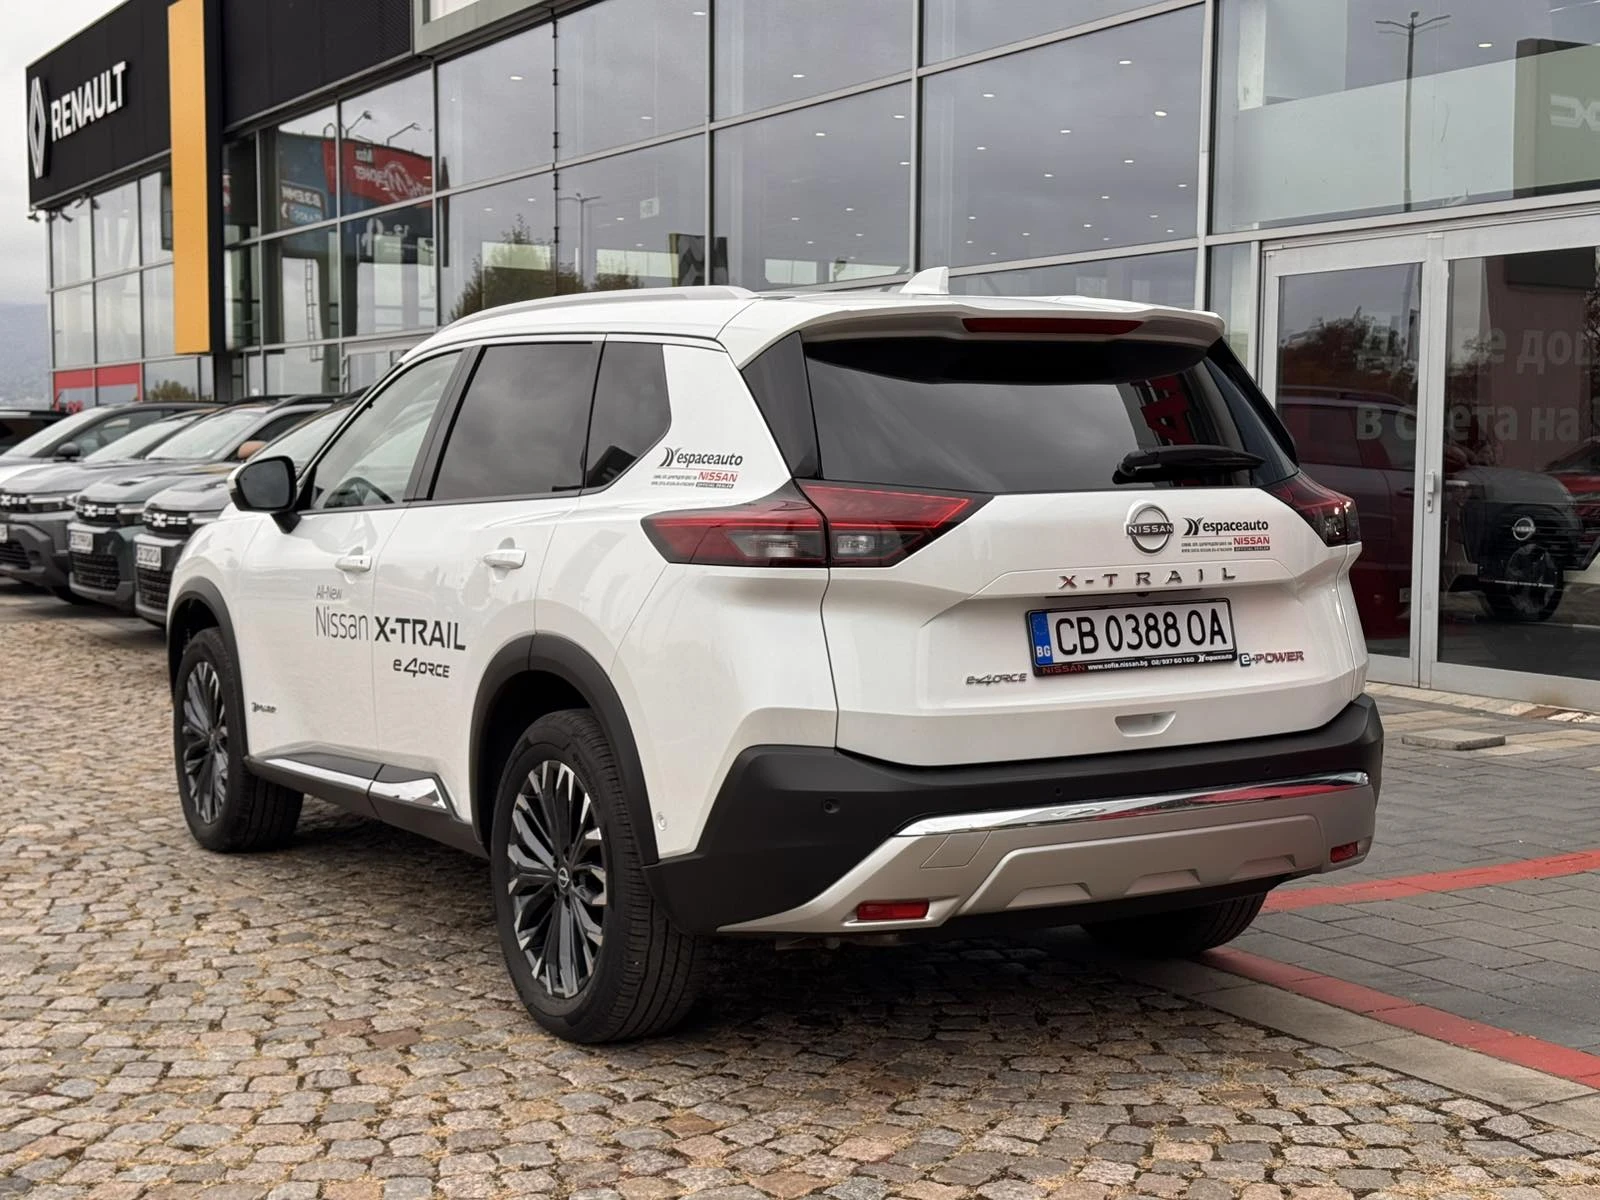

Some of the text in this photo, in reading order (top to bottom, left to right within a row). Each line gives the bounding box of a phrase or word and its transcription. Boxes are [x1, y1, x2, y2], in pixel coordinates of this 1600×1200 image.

[50, 60, 126, 142] RENAULT
[1395, 404, 1518, 441] сета
[1530, 407, 1579, 441] на
[676, 452, 743, 468] espaceauto
[698, 471, 738, 482] NISSAN
[1128, 523, 1174, 534] NISSAN
[1203, 520, 1269, 535] espaceauto
[1233, 537, 1270, 546] NISSAN
[1059, 567, 1237, 590] X-TRAIL
[315, 606, 466, 651] Nissan X-TRAIL
[1055, 608, 1227, 656] CB 0388 OA
[1037, 645, 1051, 657] BG
[1239, 650, 1304, 668] e-POWER
[1043, 663, 1085, 674] NISSAN
